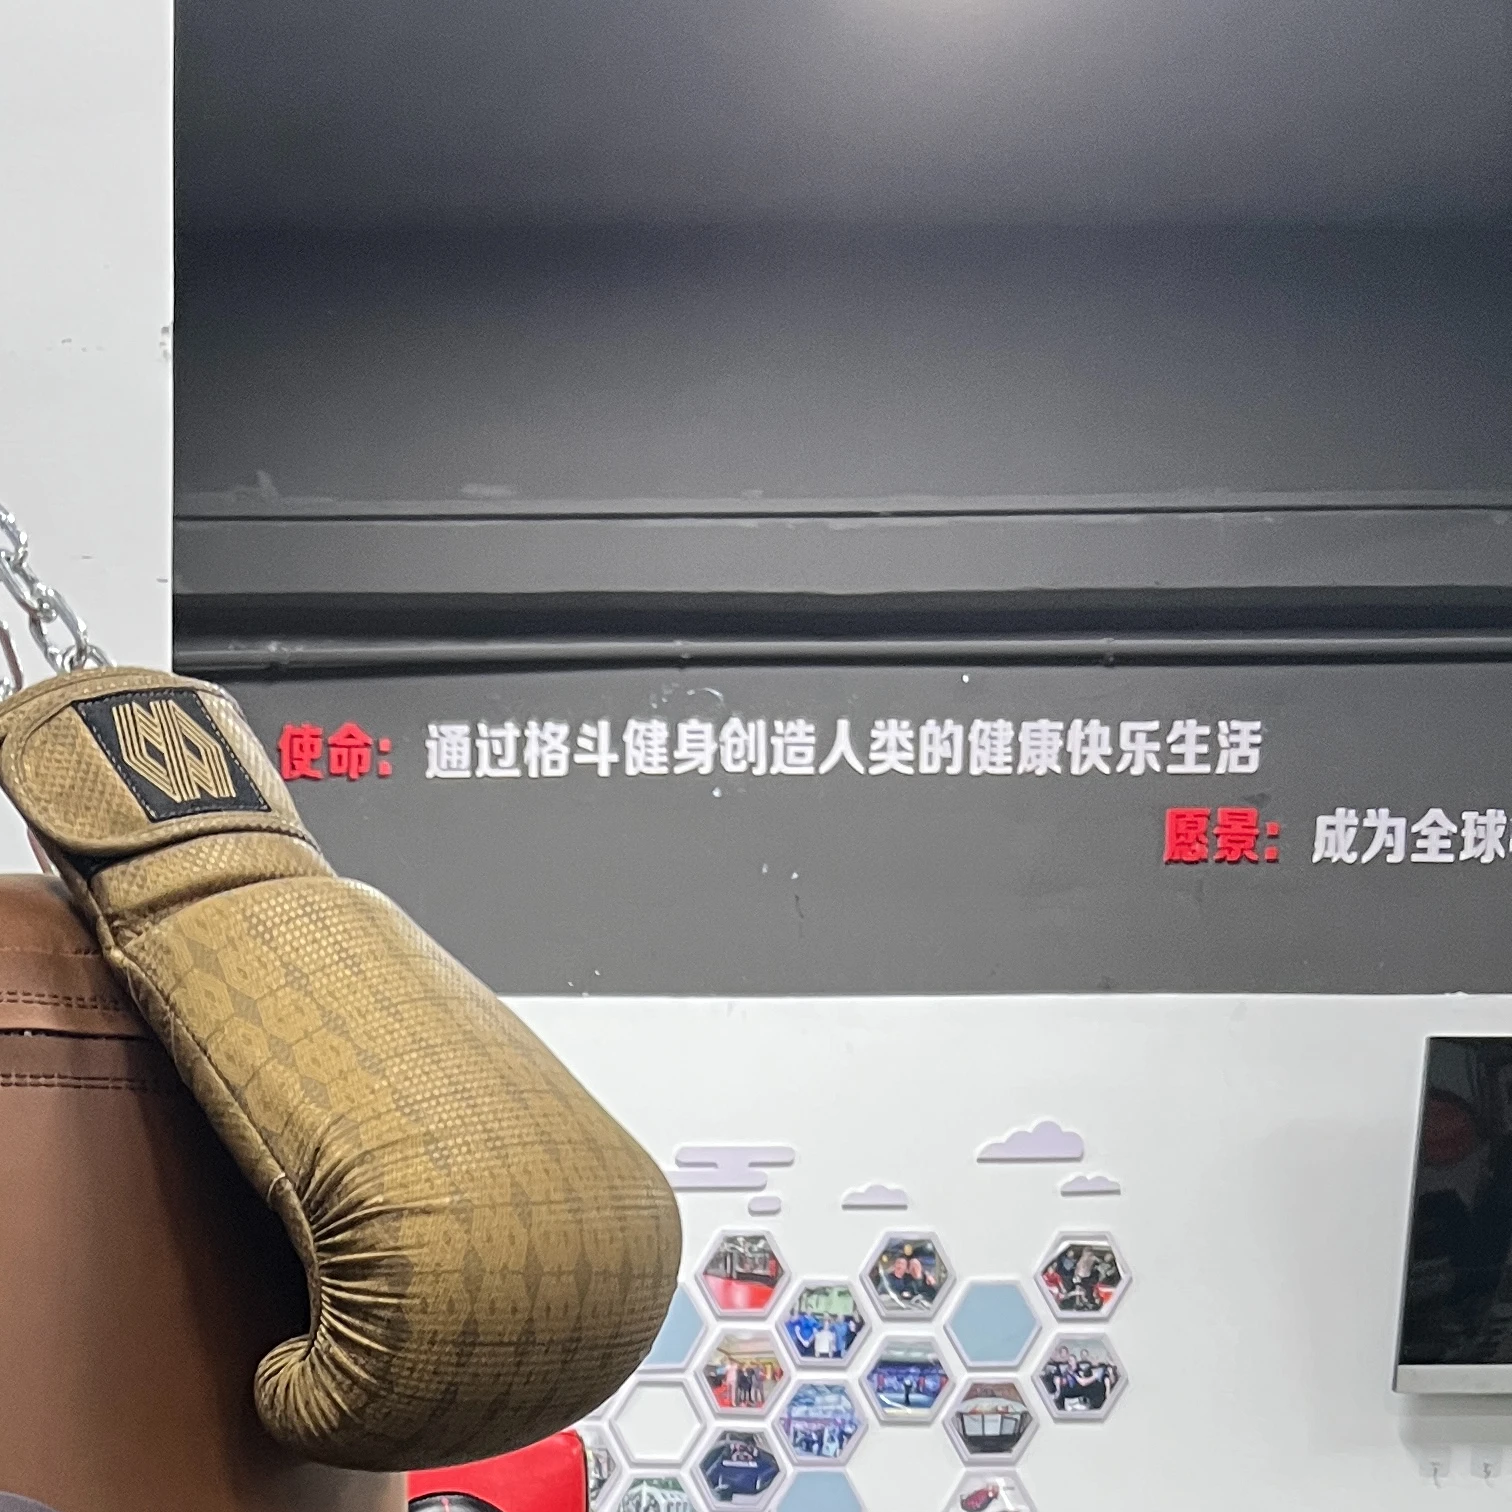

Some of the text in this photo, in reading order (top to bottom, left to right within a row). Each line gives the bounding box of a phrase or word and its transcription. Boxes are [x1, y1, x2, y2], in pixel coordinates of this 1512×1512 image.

[424, 717, 1263, 779] 通过格斗健身创造人类的健康快乐生活
[1312, 806, 1512, 864] 成为全球
